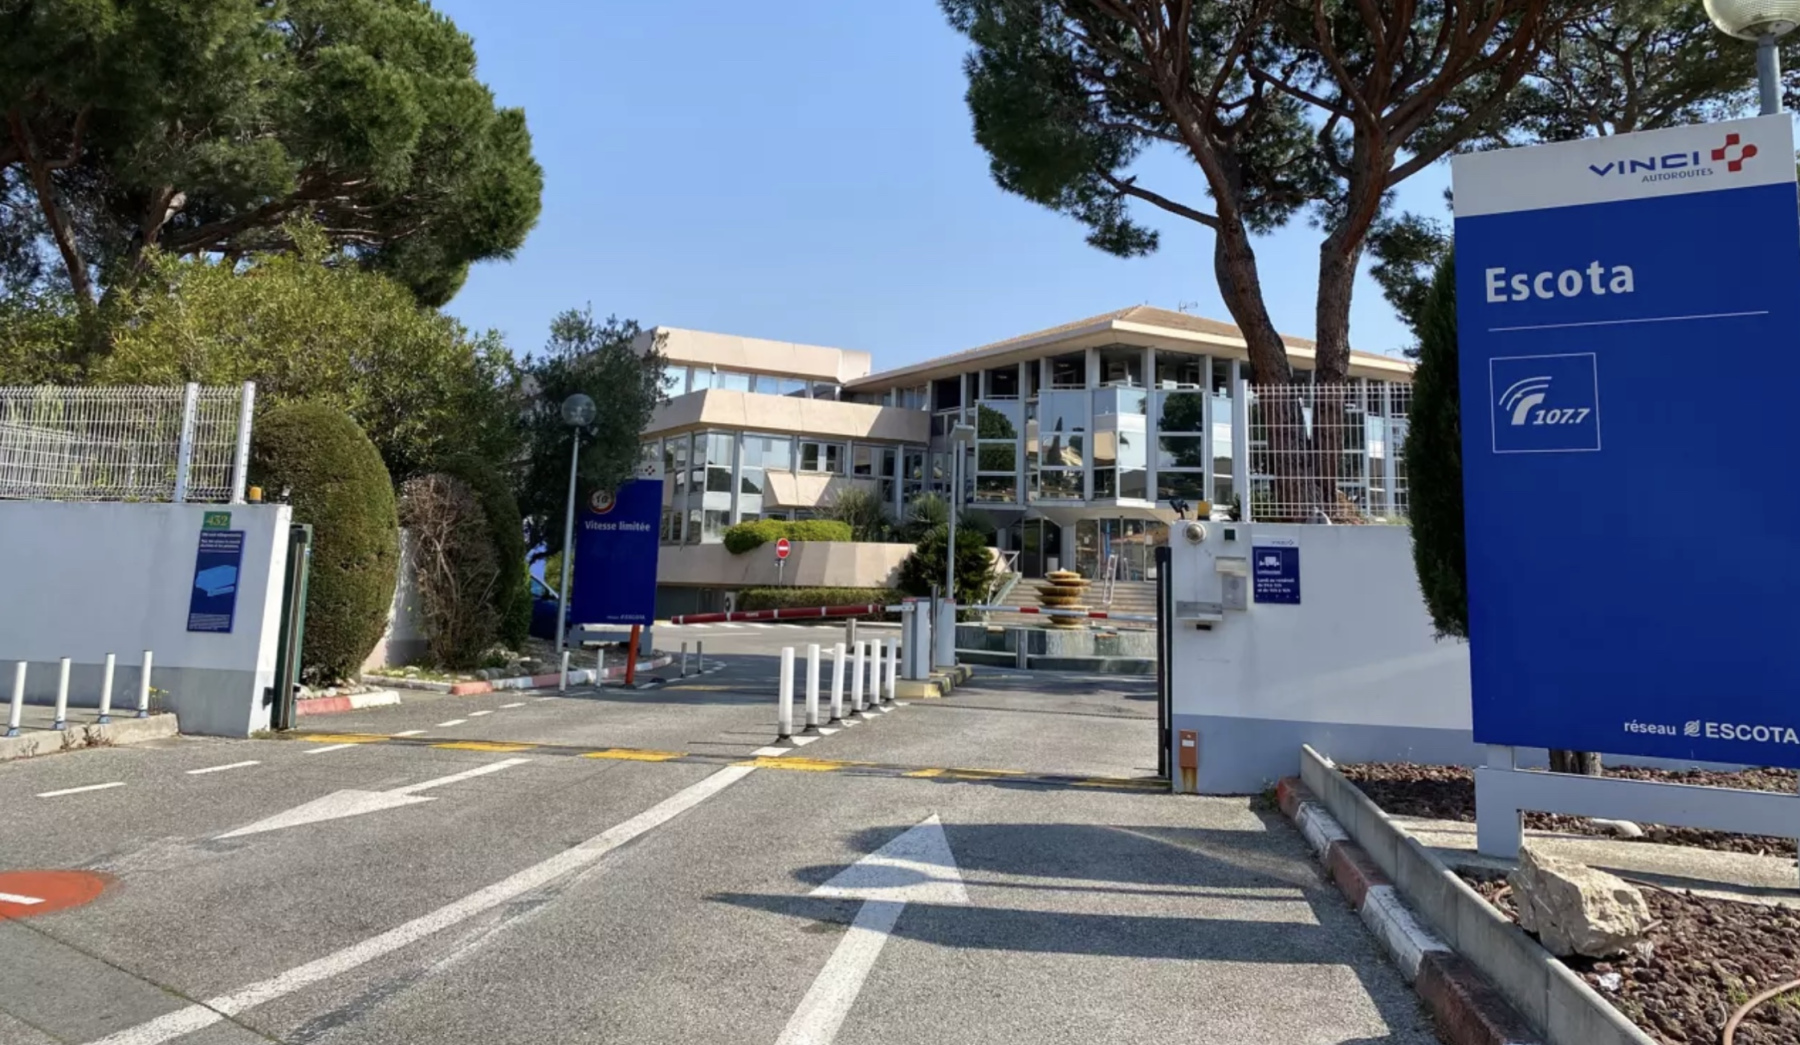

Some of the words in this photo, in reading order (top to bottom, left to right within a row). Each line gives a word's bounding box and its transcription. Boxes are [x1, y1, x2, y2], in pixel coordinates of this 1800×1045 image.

[1589, 151, 1700, 176] VINCI
[1641, 168, 1714, 183] AUTOROUTES
[1485, 260, 1635, 303] Escota
[1533, 408, 1591, 425] 107.7
[585, 521, 617, 530] Vitesse
[619, 521, 651, 531] limitée
[1624, 719, 1677, 735] réseau
[1705, 722, 1800, 744] ESCOTA
